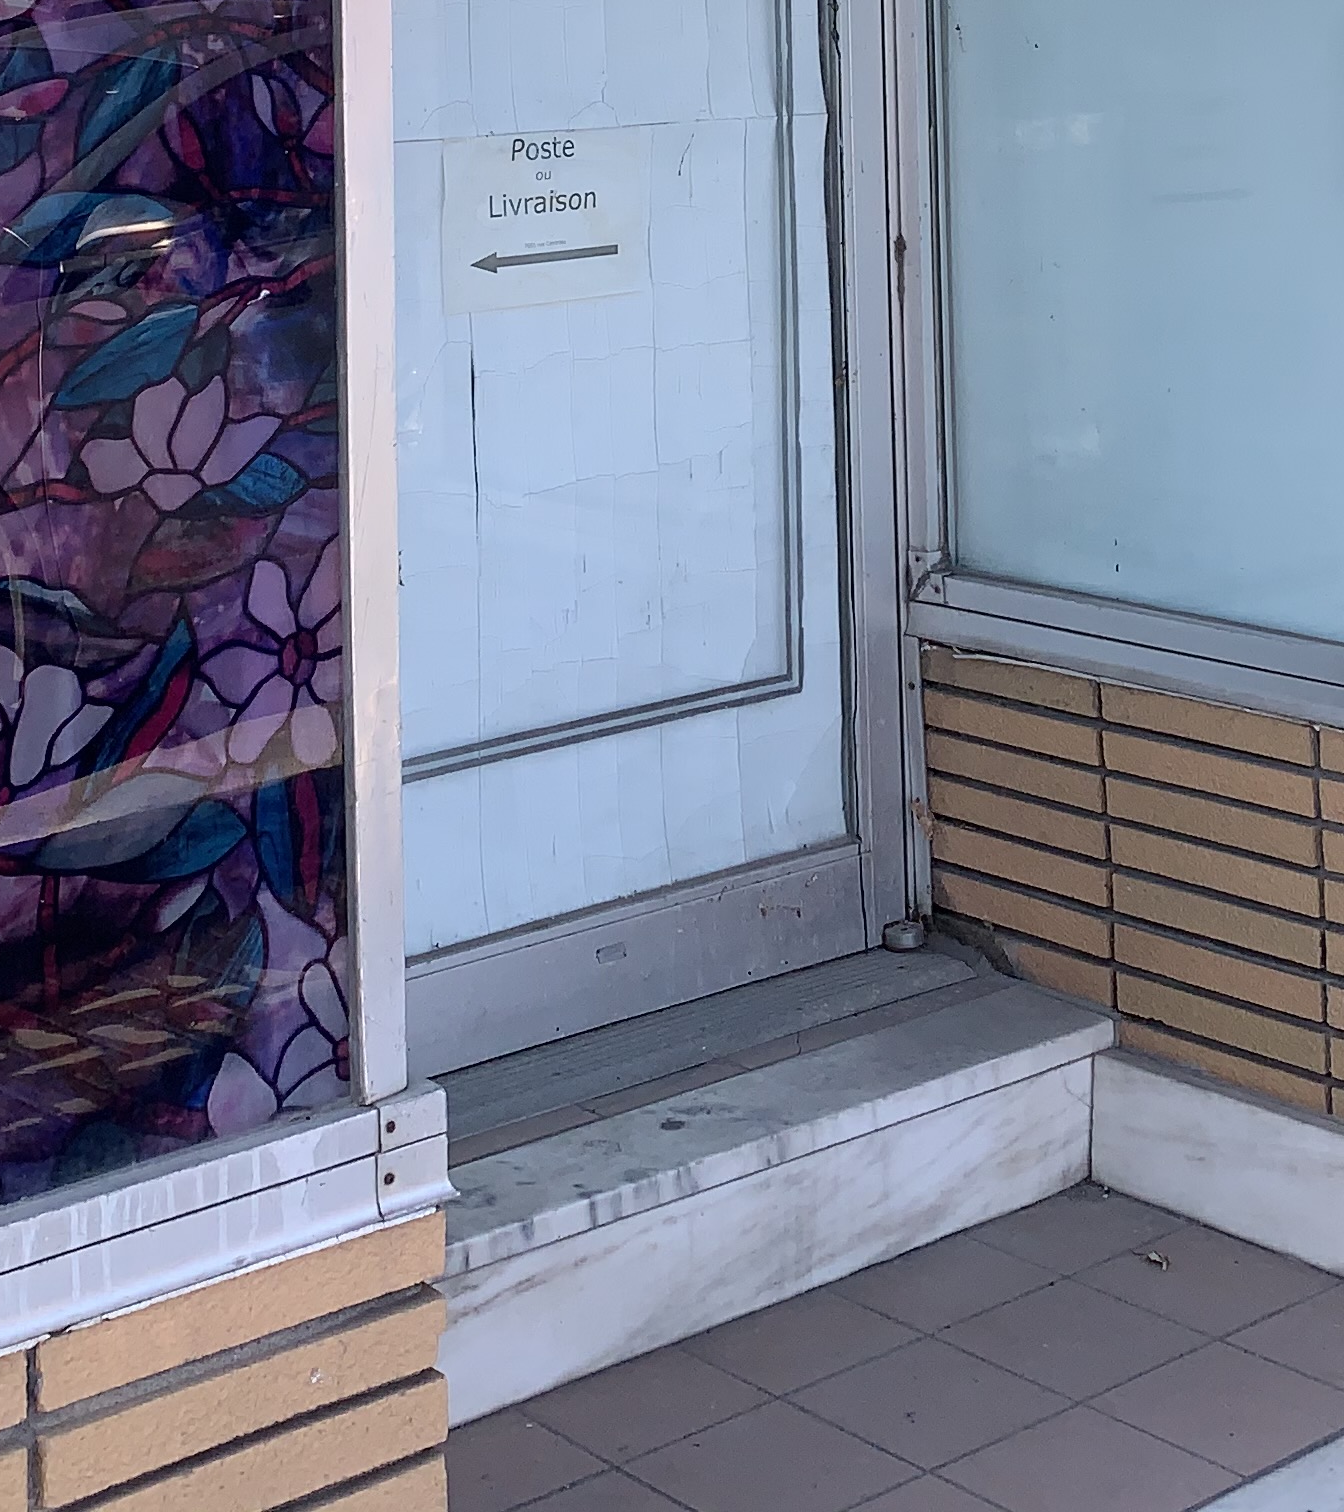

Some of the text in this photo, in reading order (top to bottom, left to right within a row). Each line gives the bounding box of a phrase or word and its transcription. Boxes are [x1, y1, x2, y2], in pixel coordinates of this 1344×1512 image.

[511, 136, 575, 161] Poste
[535, 170, 552, 181] ou
[489, 190, 597, 219] Livraison
